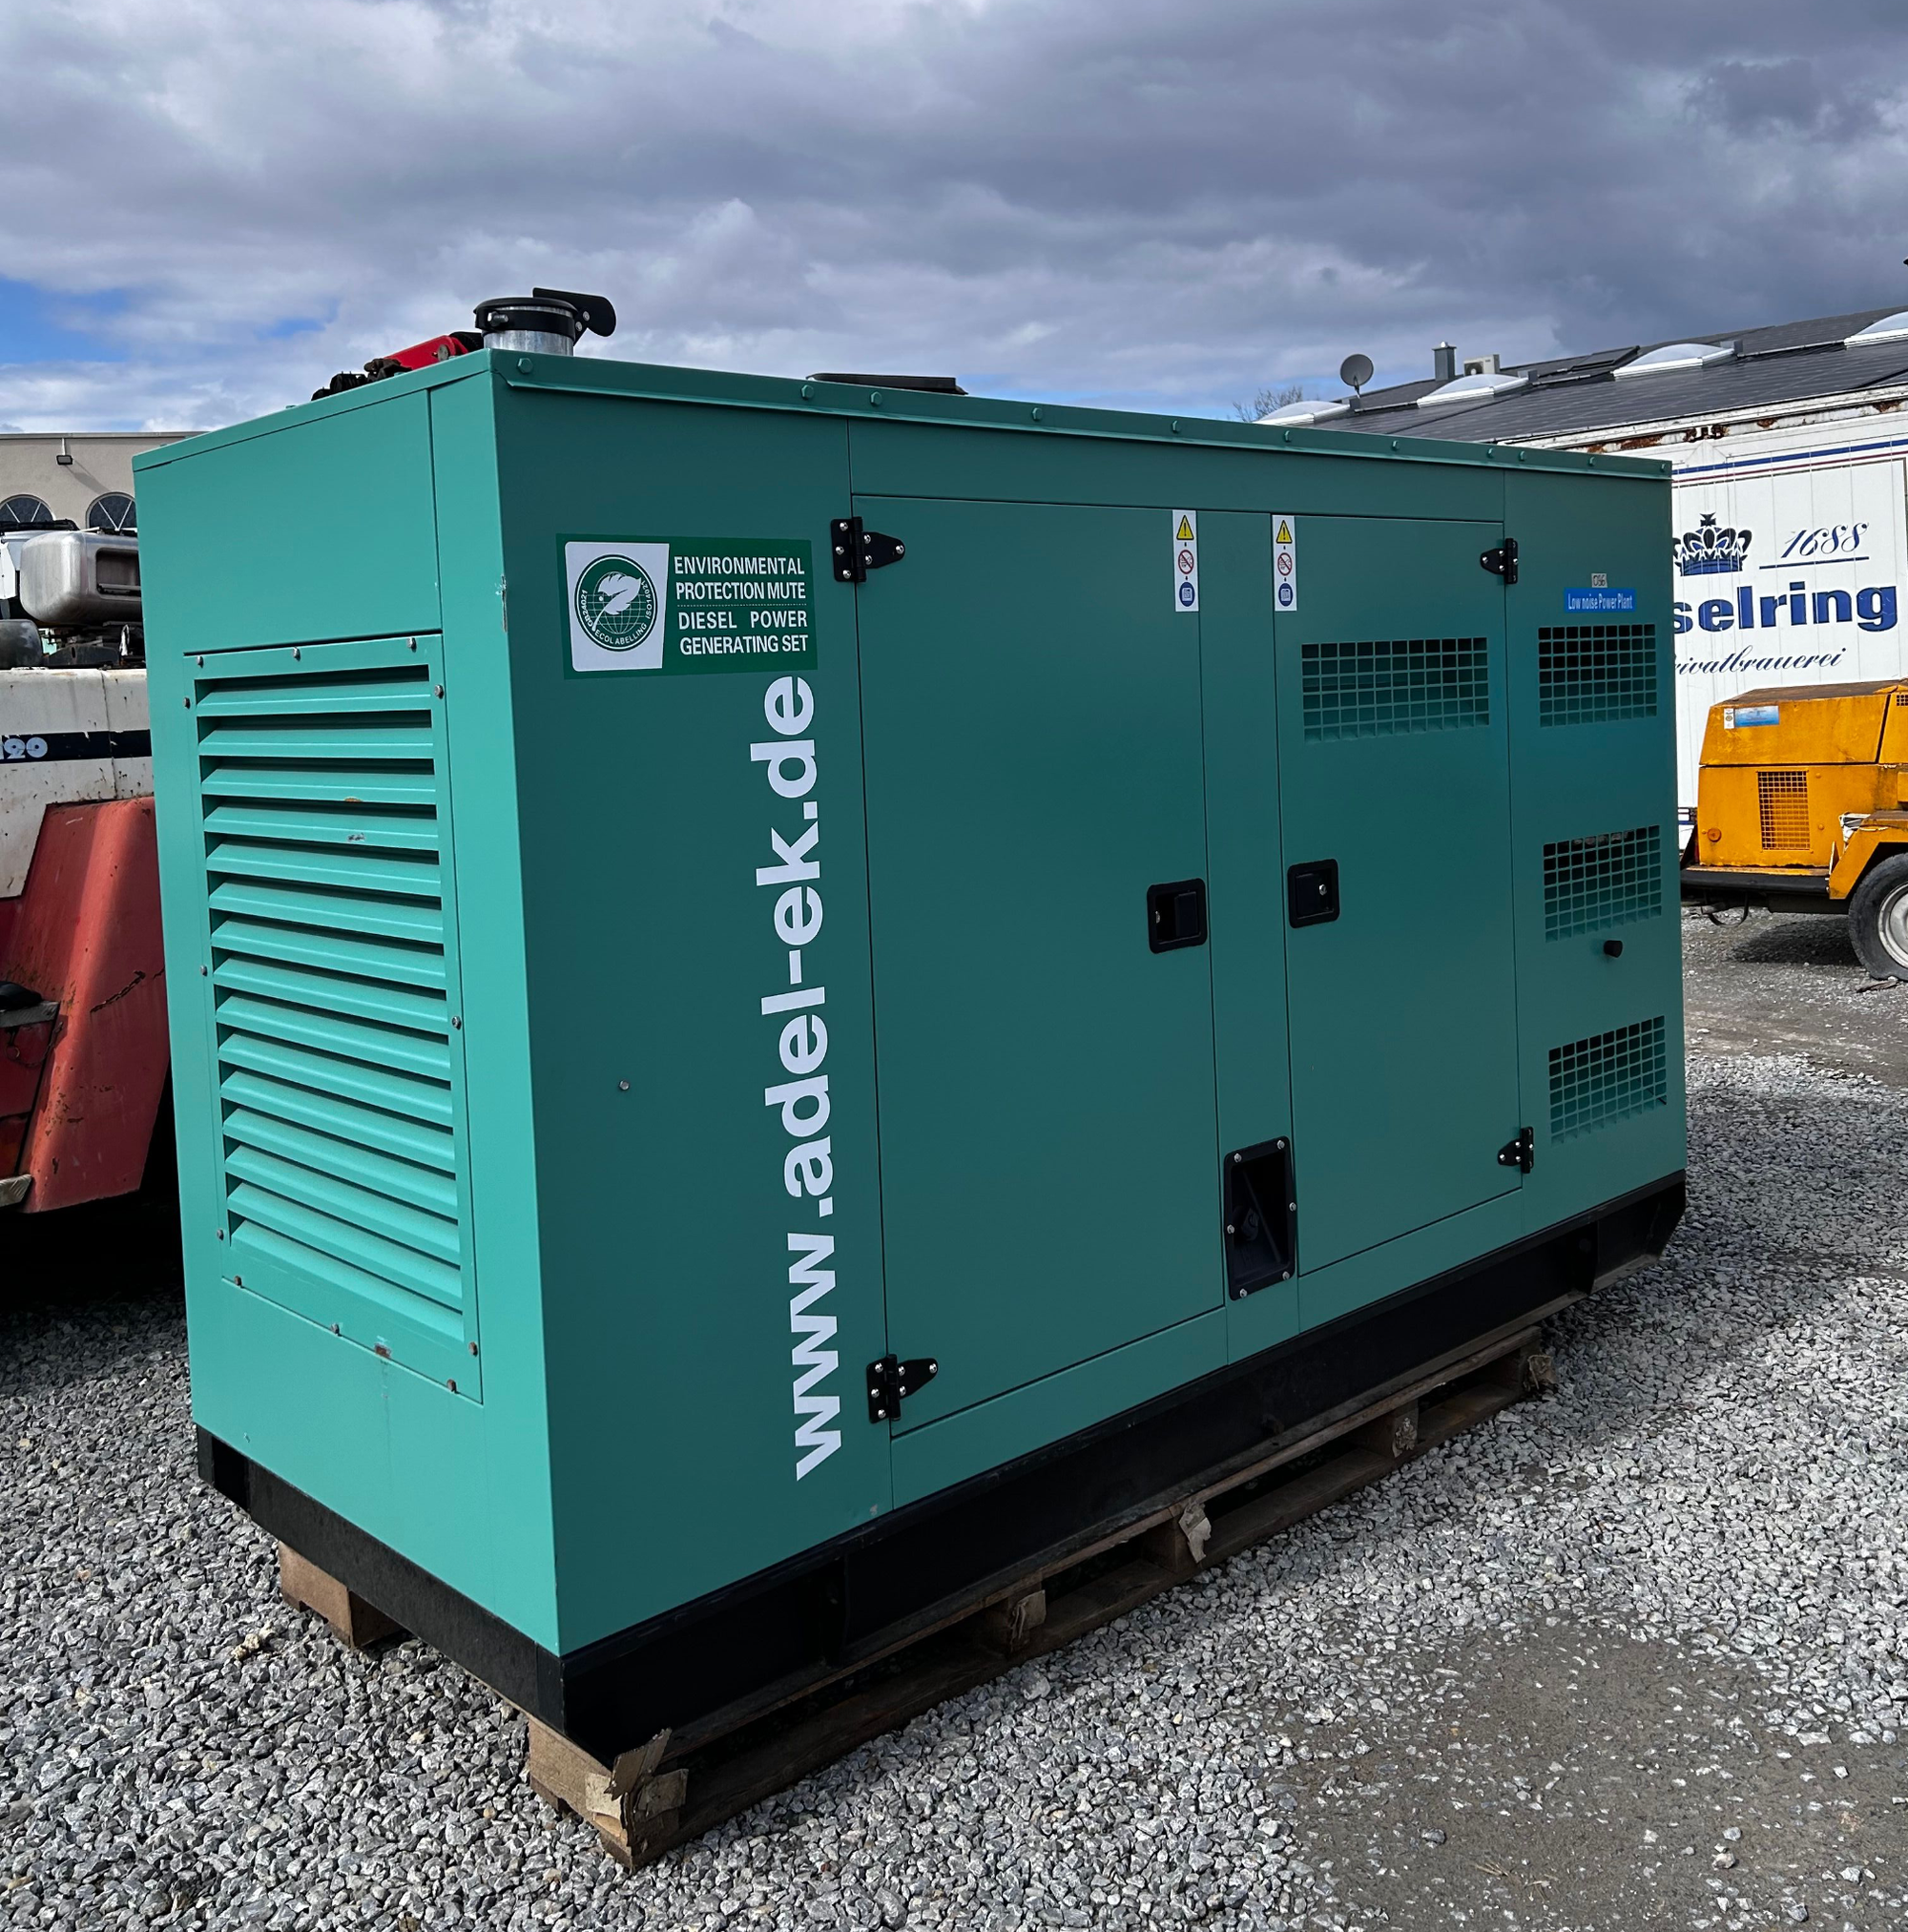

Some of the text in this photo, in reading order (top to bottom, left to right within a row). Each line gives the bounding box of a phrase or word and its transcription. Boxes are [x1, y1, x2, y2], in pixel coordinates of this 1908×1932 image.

[1780, 522, 1869, 558] 1688
[674, 556, 805, 575] ENVIRONMENTAL
[675, 581, 806, 600] PROTECTION MUTE
[1567, 592, 1632, 610] Low noise Power Plant
[678, 610, 808, 630] DIESEL POWER
[679, 634, 809, 655] GENERATING SET
[749, 675, 842, 1482] www.adel-ek.de
